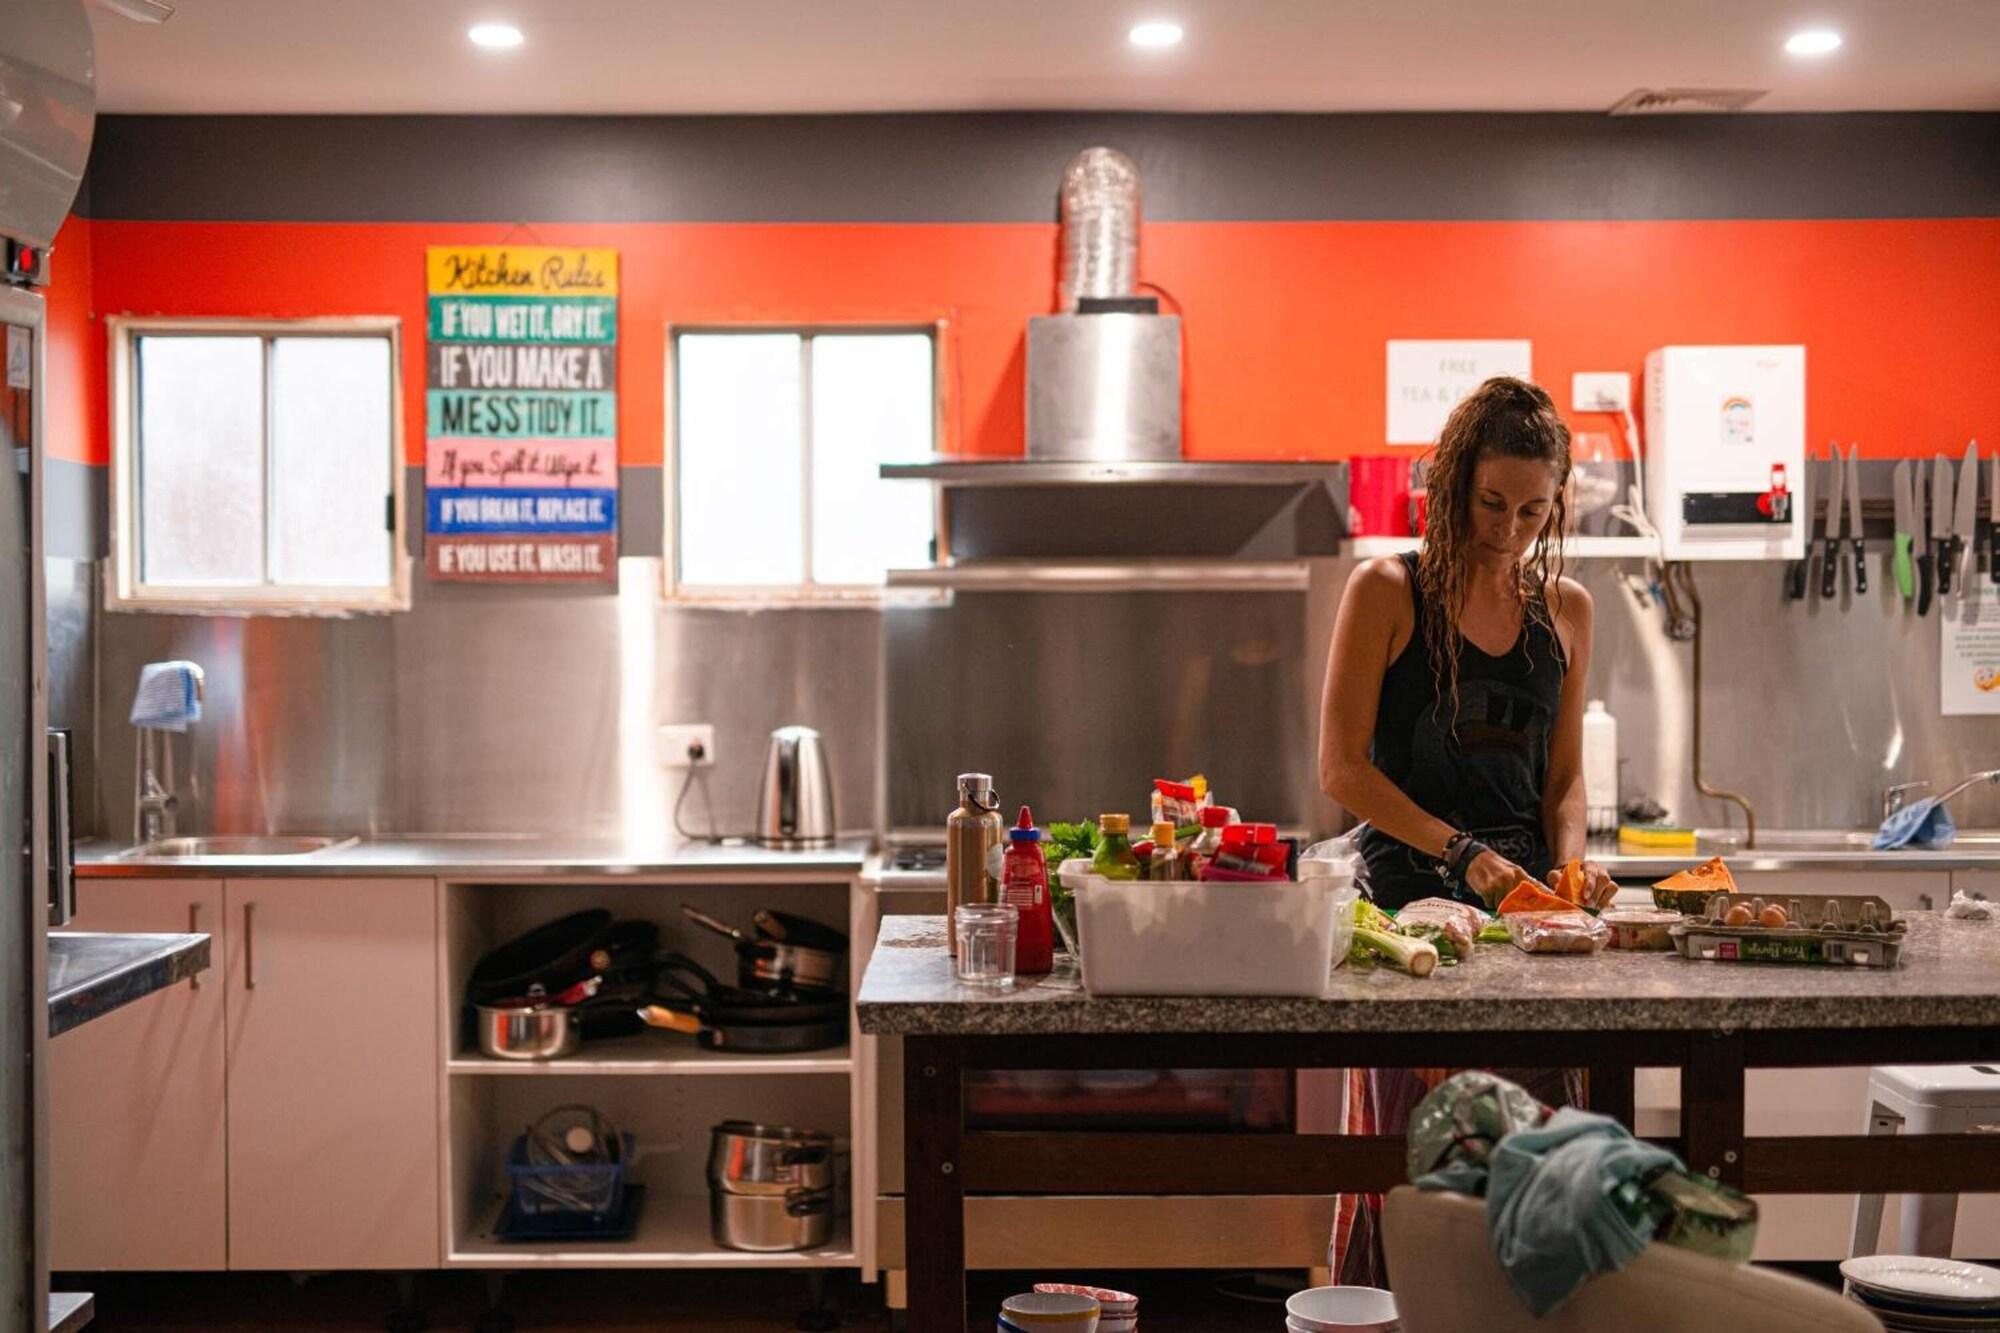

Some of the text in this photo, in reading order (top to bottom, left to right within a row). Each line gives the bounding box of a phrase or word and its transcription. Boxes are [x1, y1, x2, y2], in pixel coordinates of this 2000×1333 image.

[445, 252, 605, 289] Kitchen Rules
[441, 304, 457, 337] IF
[461, 304, 492, 338] YOU
[495, 306, 527, 338] WET
[440, 347, 603, 388] IF YOU MAKE A
[1439, 359, 1477, 375] FREE
[1402, 386, 1435, 402] TEA
[441, 396, 521, 434] MESS
[526, 397, 573, 434] TIDY
[459, 461, 484, 488] you
[438, 544, 455, 573] IF
[456, 544, 486, 573] YOU
[488, 544, 517, 573] USE
[538, 544, 582, 573] WASH
